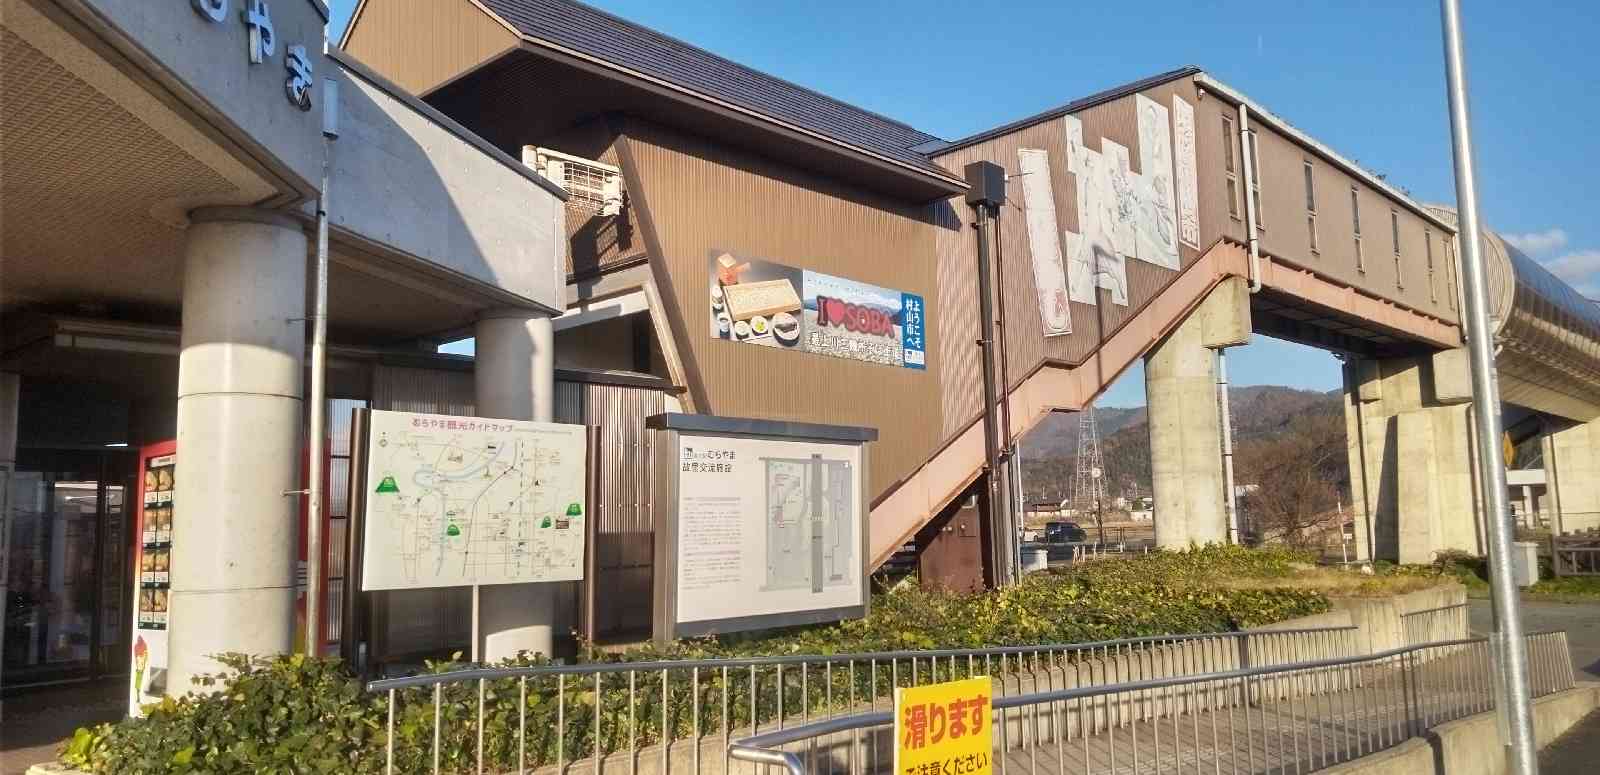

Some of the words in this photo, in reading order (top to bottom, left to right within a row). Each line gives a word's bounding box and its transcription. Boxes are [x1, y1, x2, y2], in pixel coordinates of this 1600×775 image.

[846, 302, 895, 339] SOBA
[905, 298, 914, 348] 村山市へ
[913, 300, 921, 348] ようこそ
[412, 416, 513, 433] むらやま観光ガイドマップ
[904, 694, 989, 750] 滑ります
